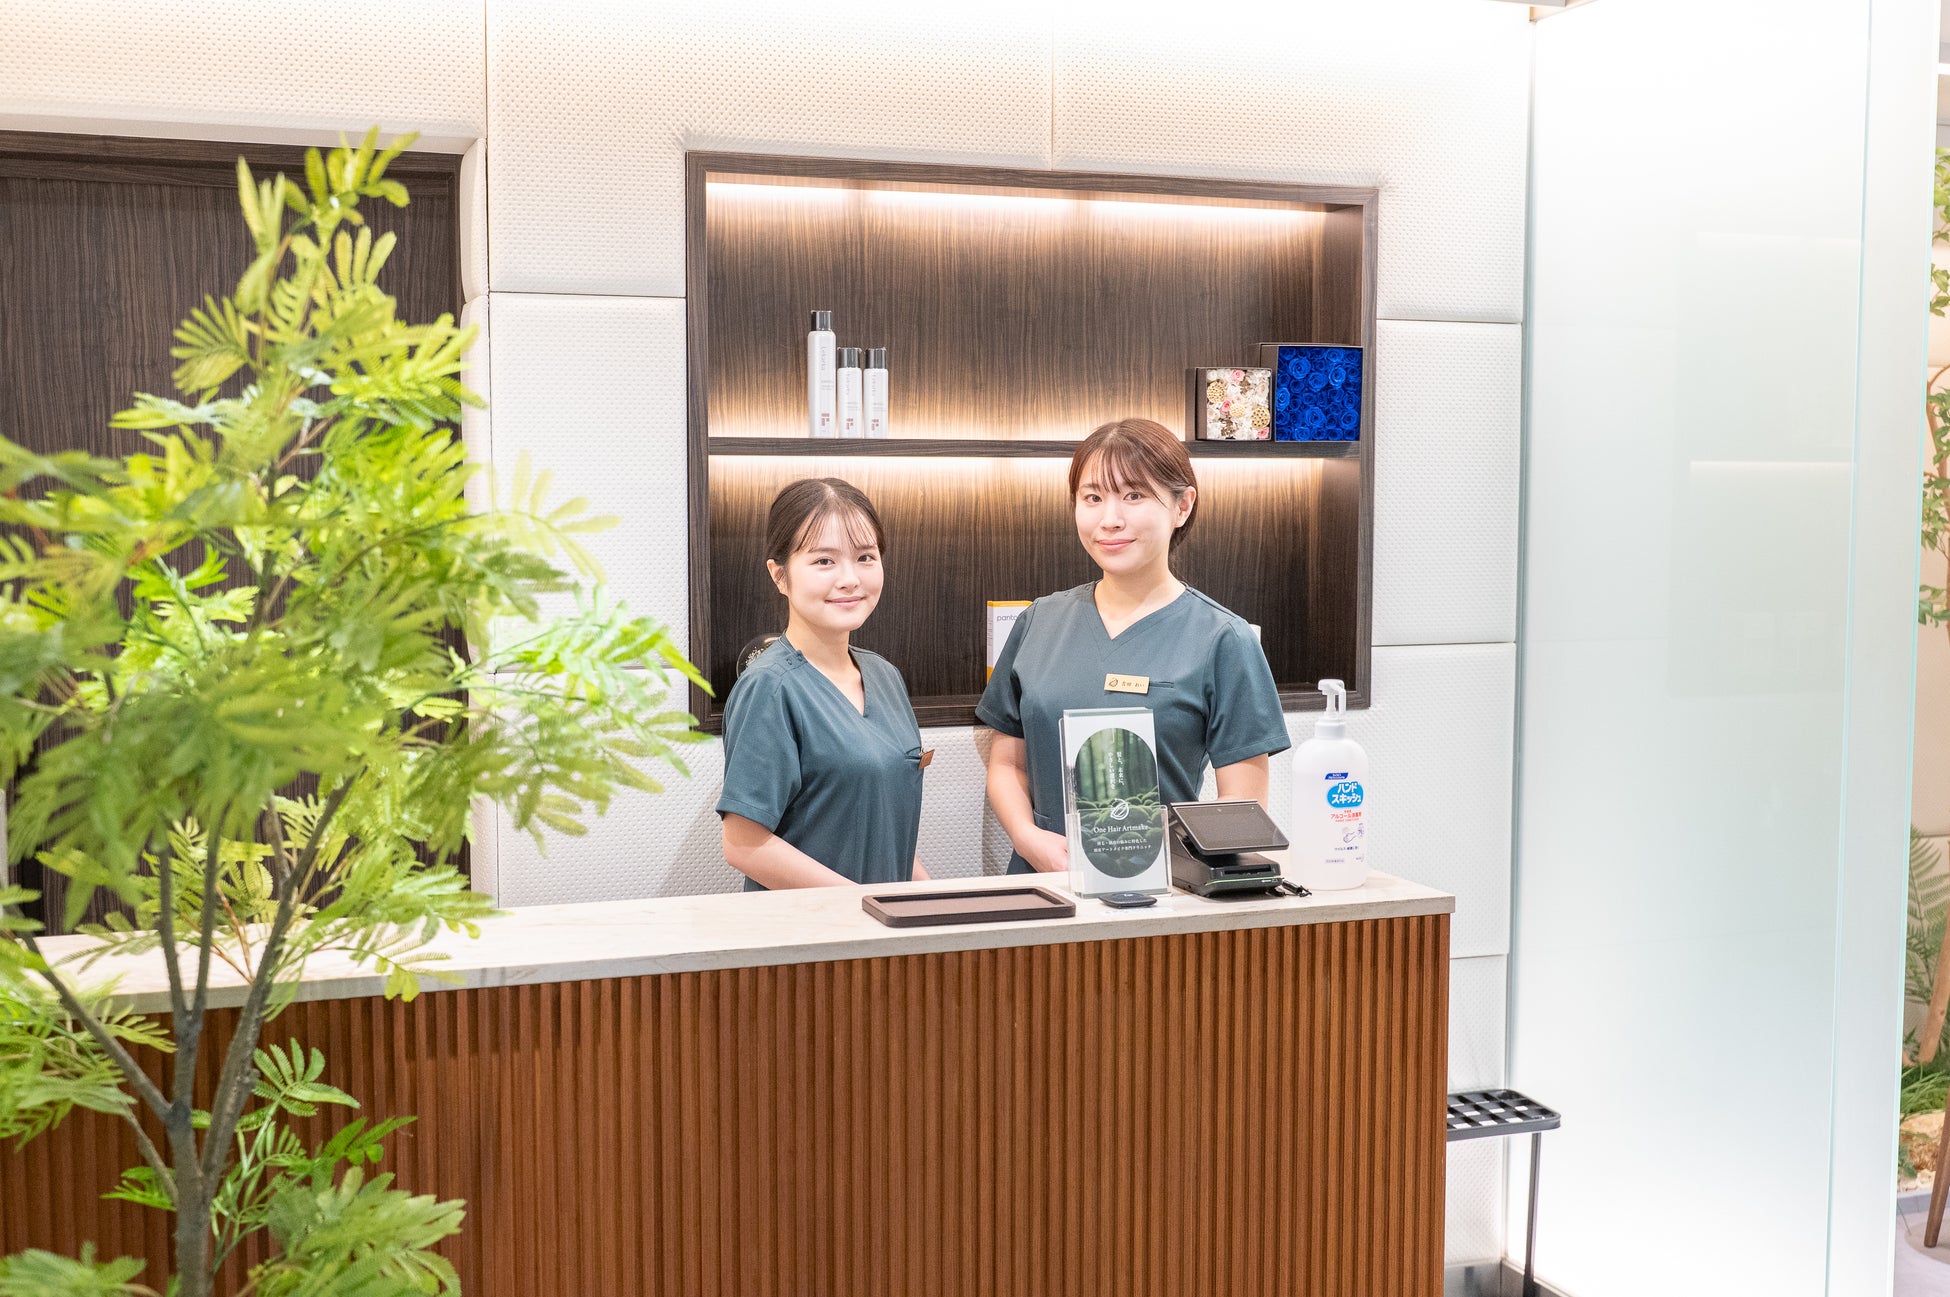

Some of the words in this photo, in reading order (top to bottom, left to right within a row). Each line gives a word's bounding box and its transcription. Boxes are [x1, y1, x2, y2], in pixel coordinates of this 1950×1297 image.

[1337, 783, 1357, 793] ハンド
[1331, 793, 1361, 804] スキッシュ
